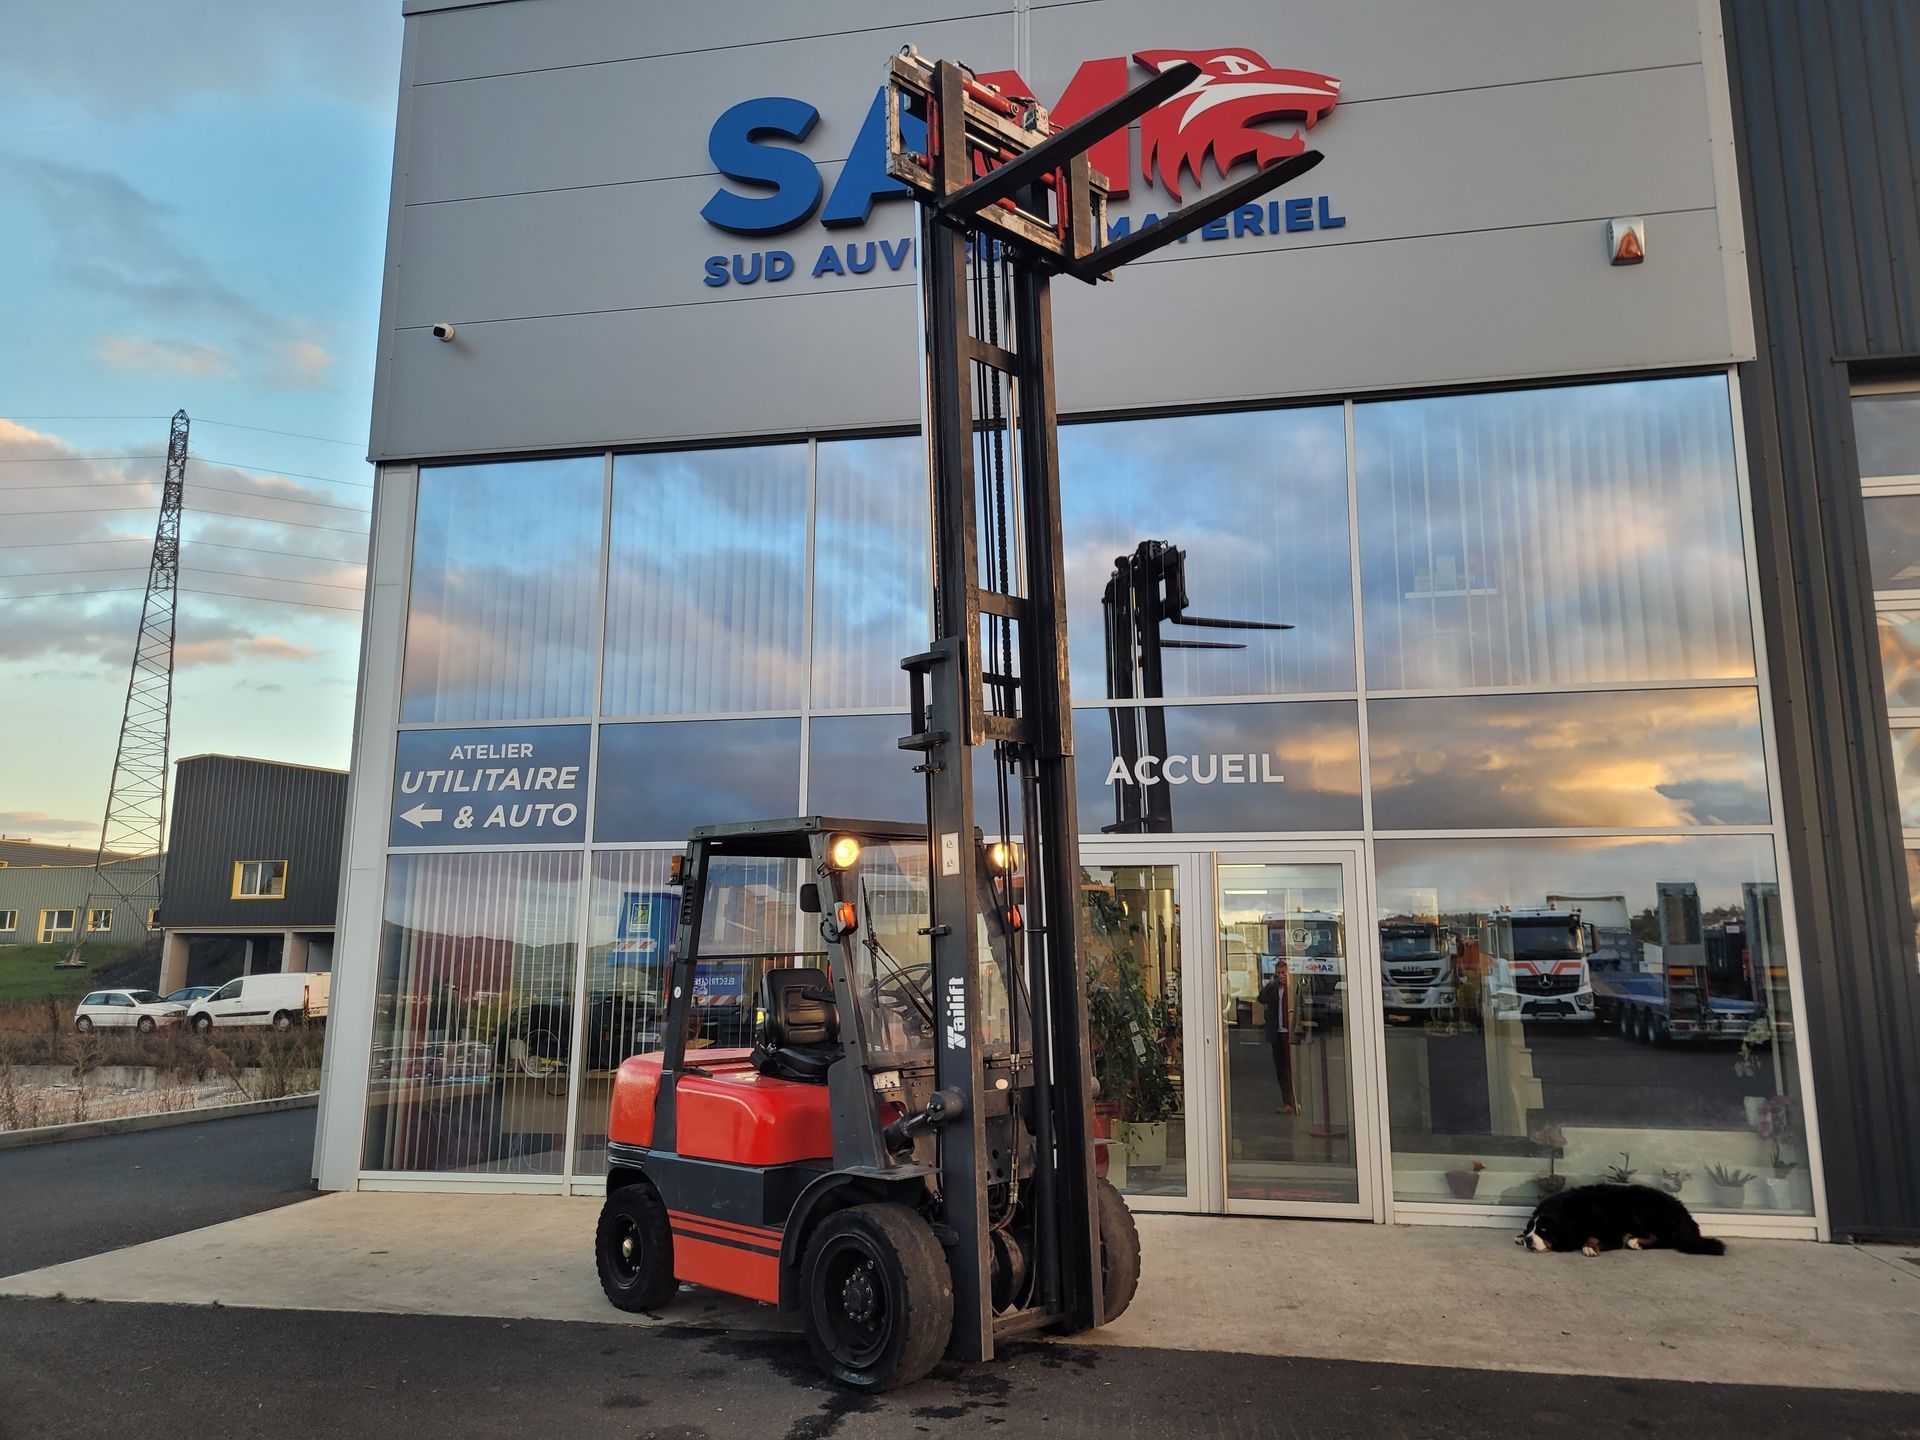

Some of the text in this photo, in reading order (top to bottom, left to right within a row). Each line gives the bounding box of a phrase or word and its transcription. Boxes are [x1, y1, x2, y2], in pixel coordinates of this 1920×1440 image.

[703, 250, 794, 287] SUD
[450, 743, 534, 760] ATELIER
[401, 766, 580, 794] UTILITAIRE
[1104, 753, 1285, 786] ACCUEIL
[453, 803, 578, 829] & AUTO
[946, 977, 966, 1050] Tailift
